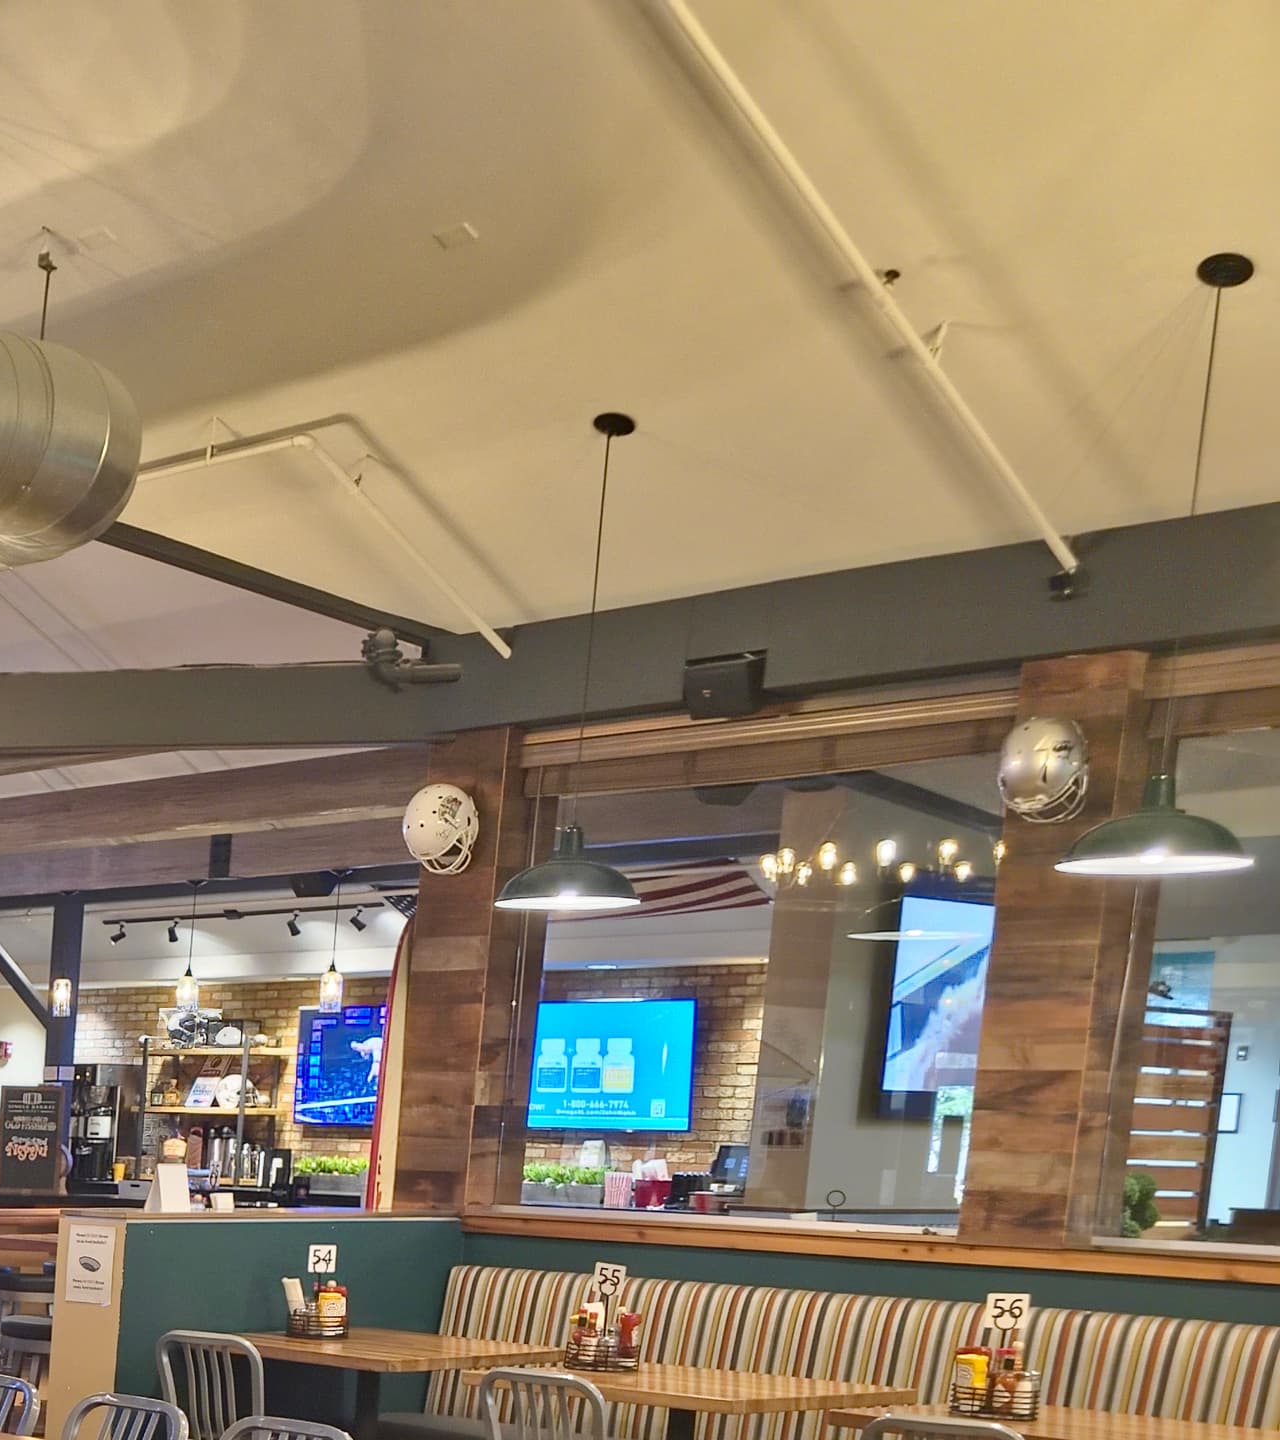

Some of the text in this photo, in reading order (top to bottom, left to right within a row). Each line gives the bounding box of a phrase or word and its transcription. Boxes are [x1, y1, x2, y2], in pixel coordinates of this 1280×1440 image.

[312, 1248, 333, 1265] 54
[597, 1267, 622, 1287] 55
[991, 1298, 1024, 1319] 56
